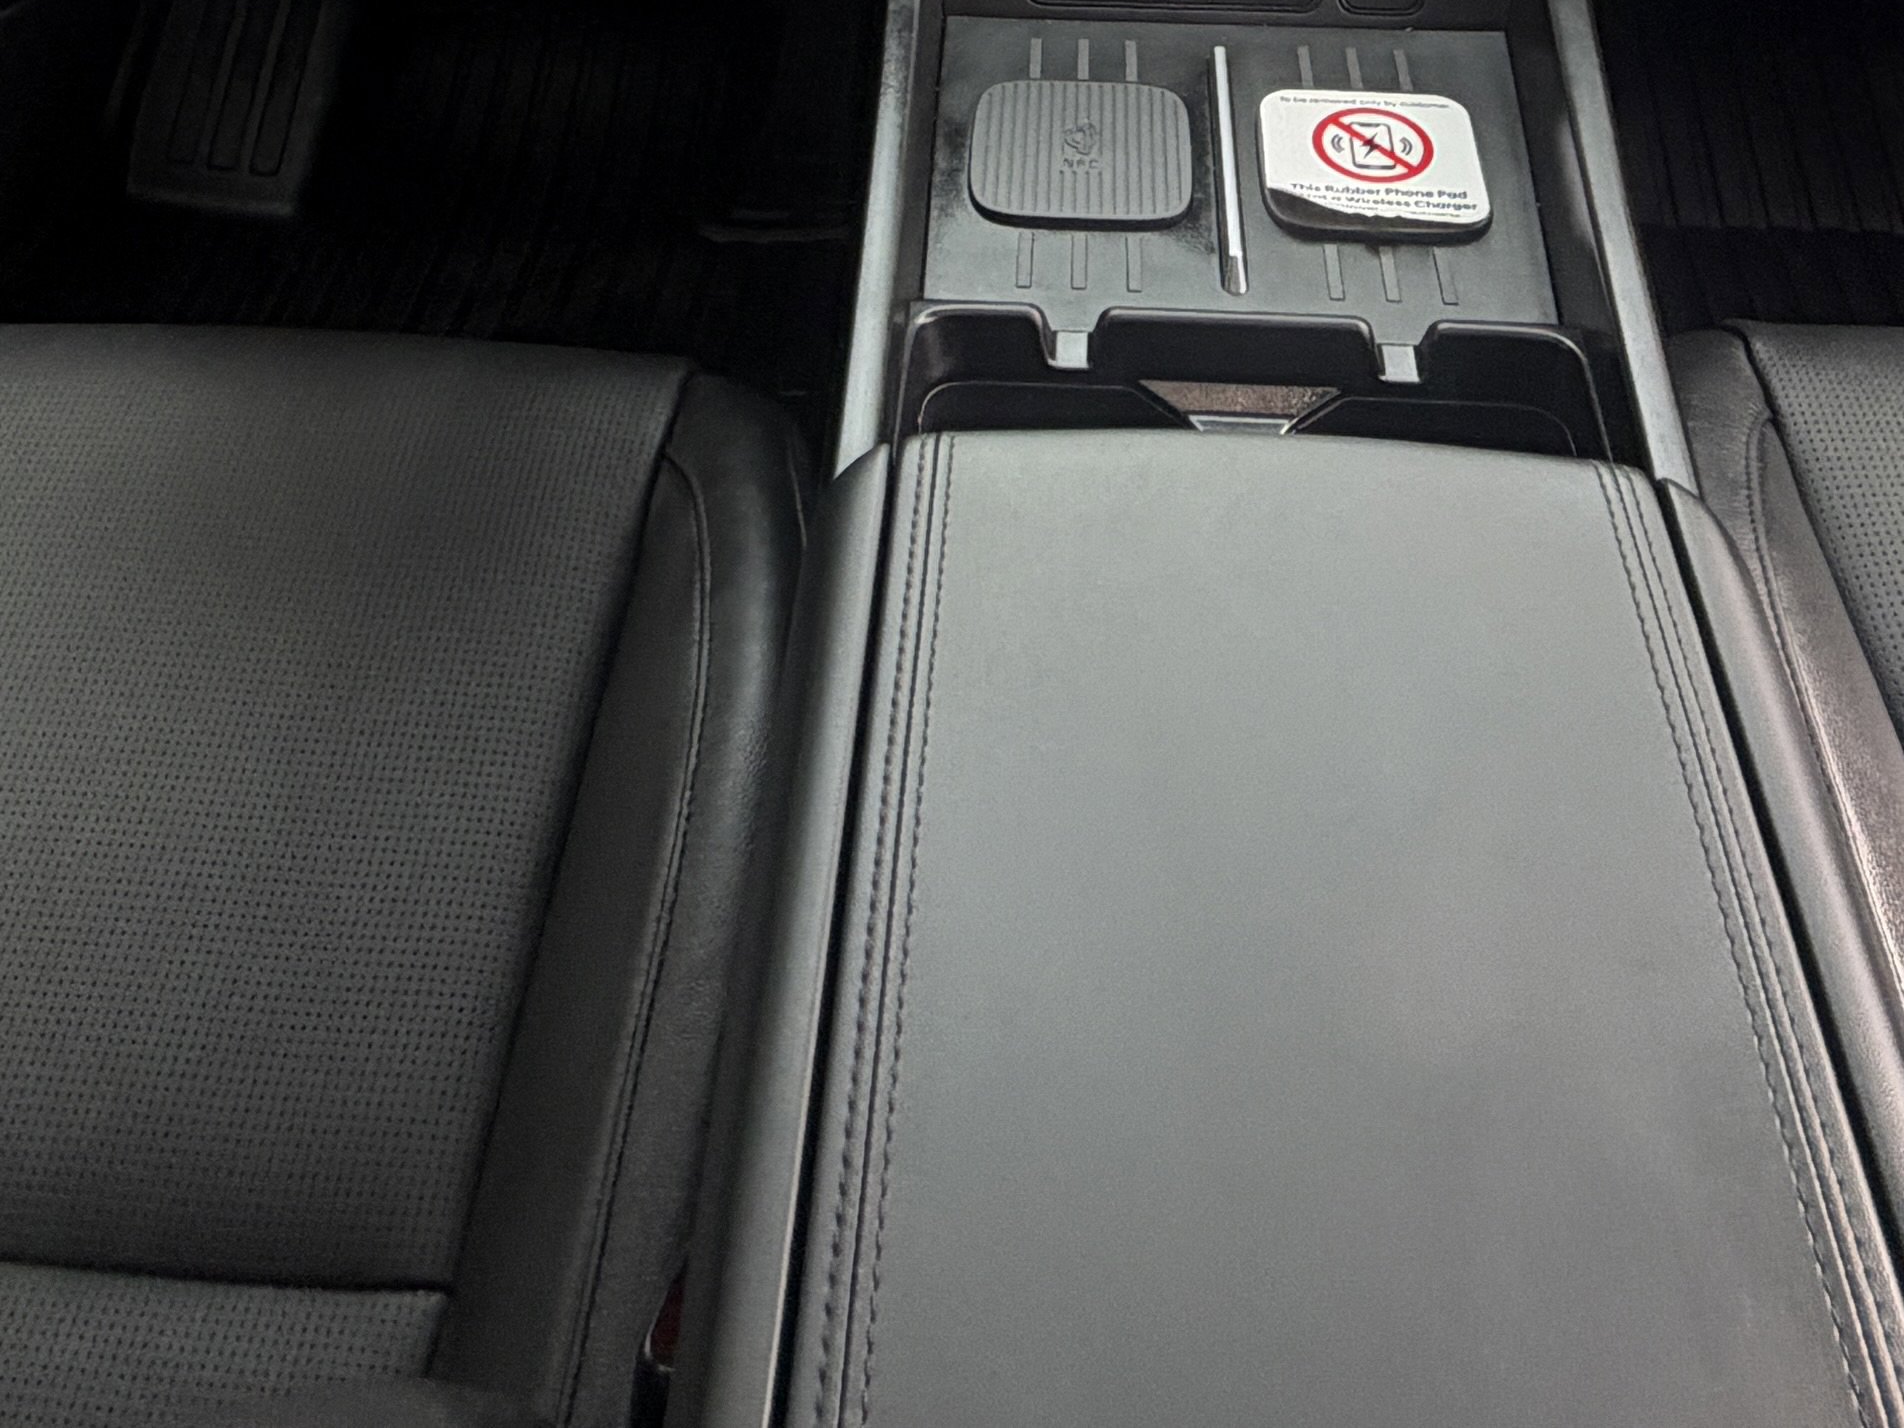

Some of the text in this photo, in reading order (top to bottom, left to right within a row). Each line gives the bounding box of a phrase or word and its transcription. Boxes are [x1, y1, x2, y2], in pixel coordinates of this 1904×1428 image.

[1063, 157, 1099, 169] NFC
[1325, 185, 1381, 196] Rubber
[1384, 187, 1434, 199] Phone
[1437, 190, 1468, 200] Pad
[1345, 197, 1411, 208] Wireless
[1414, 199, 1477, 211] Charger
